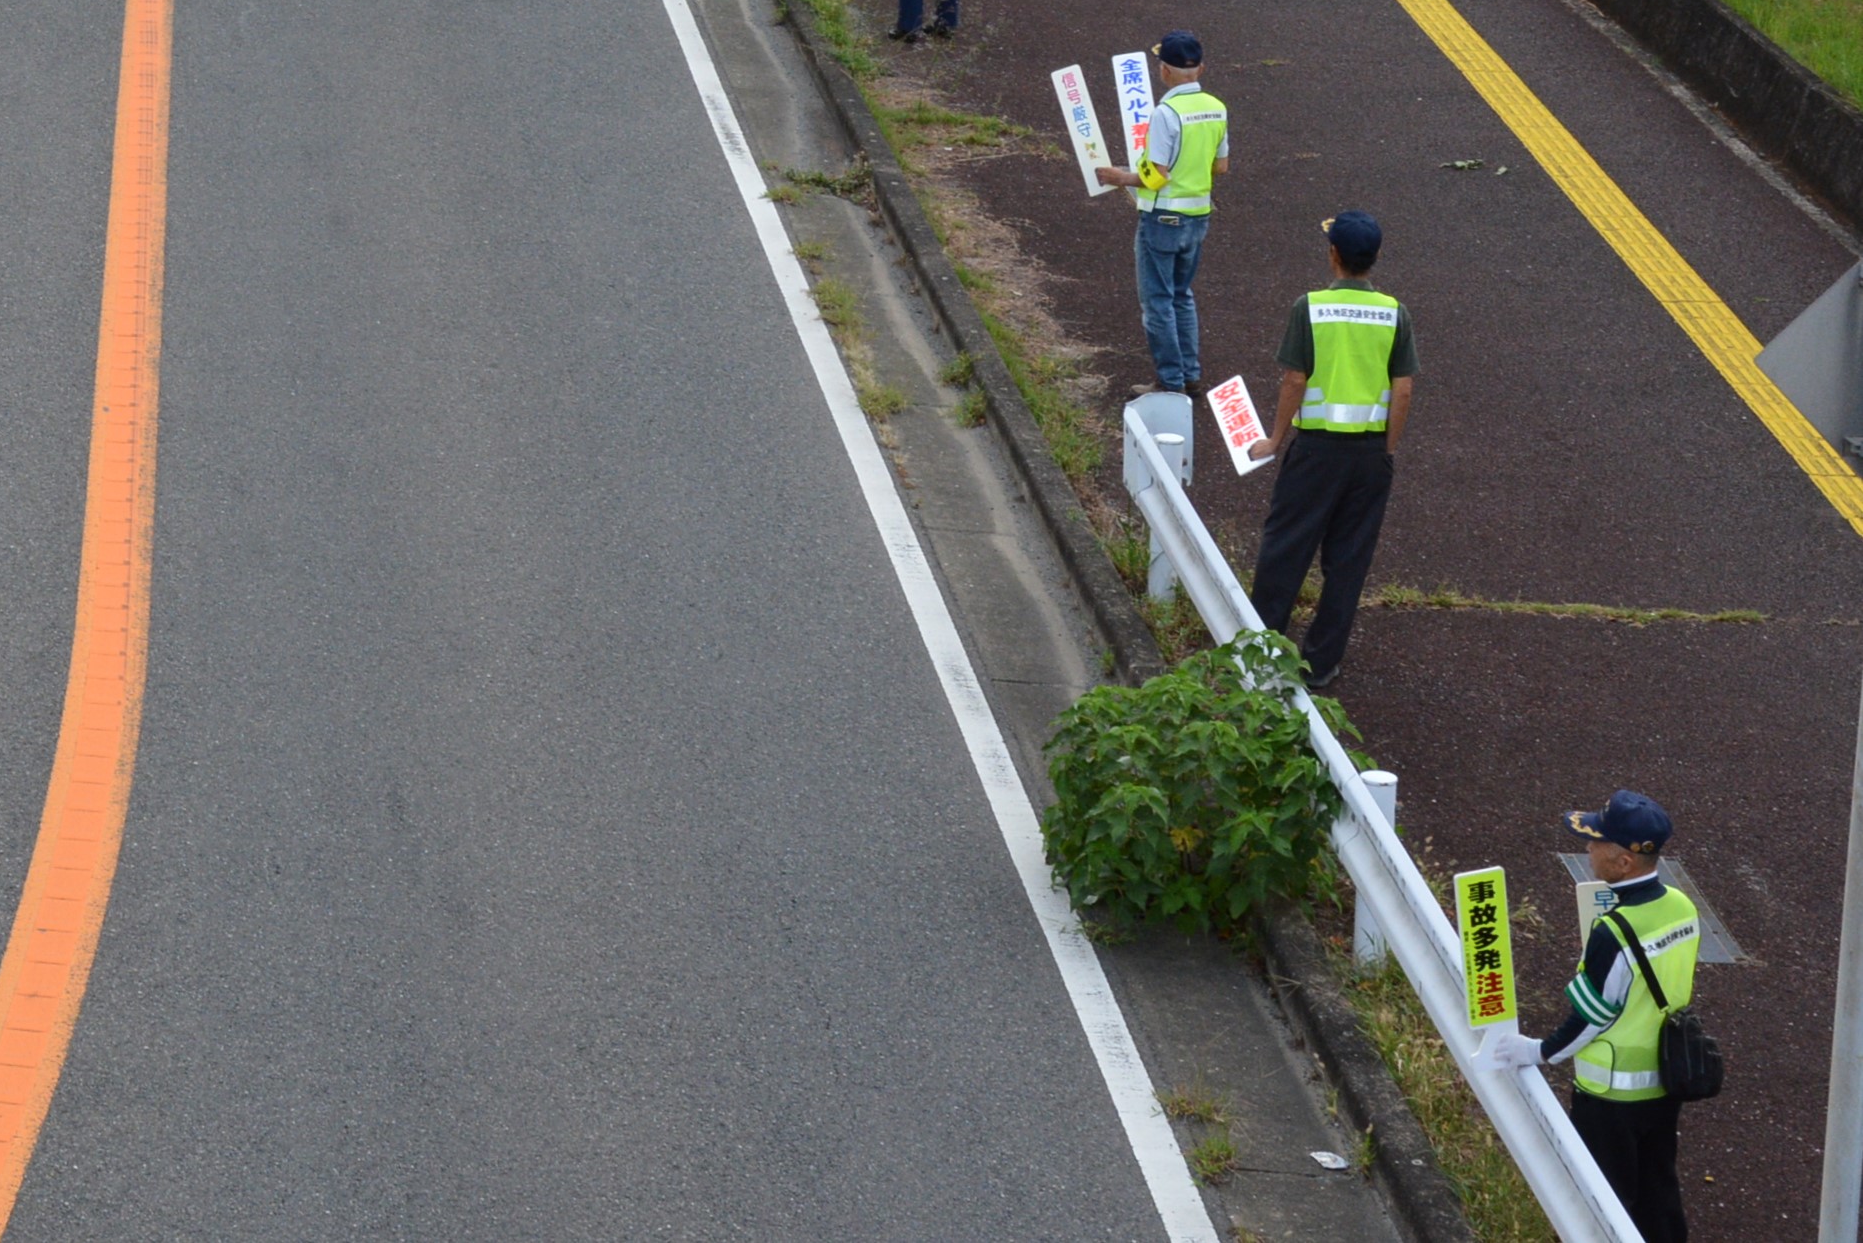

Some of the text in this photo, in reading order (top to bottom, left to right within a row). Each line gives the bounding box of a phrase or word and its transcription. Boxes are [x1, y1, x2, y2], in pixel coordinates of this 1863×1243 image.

[1061, 71, 1091, 138] 信号厳守
[1214, 380, 1259, 448] 安全運転
[1467, 880, 1506, 1018] 事故多発注意
